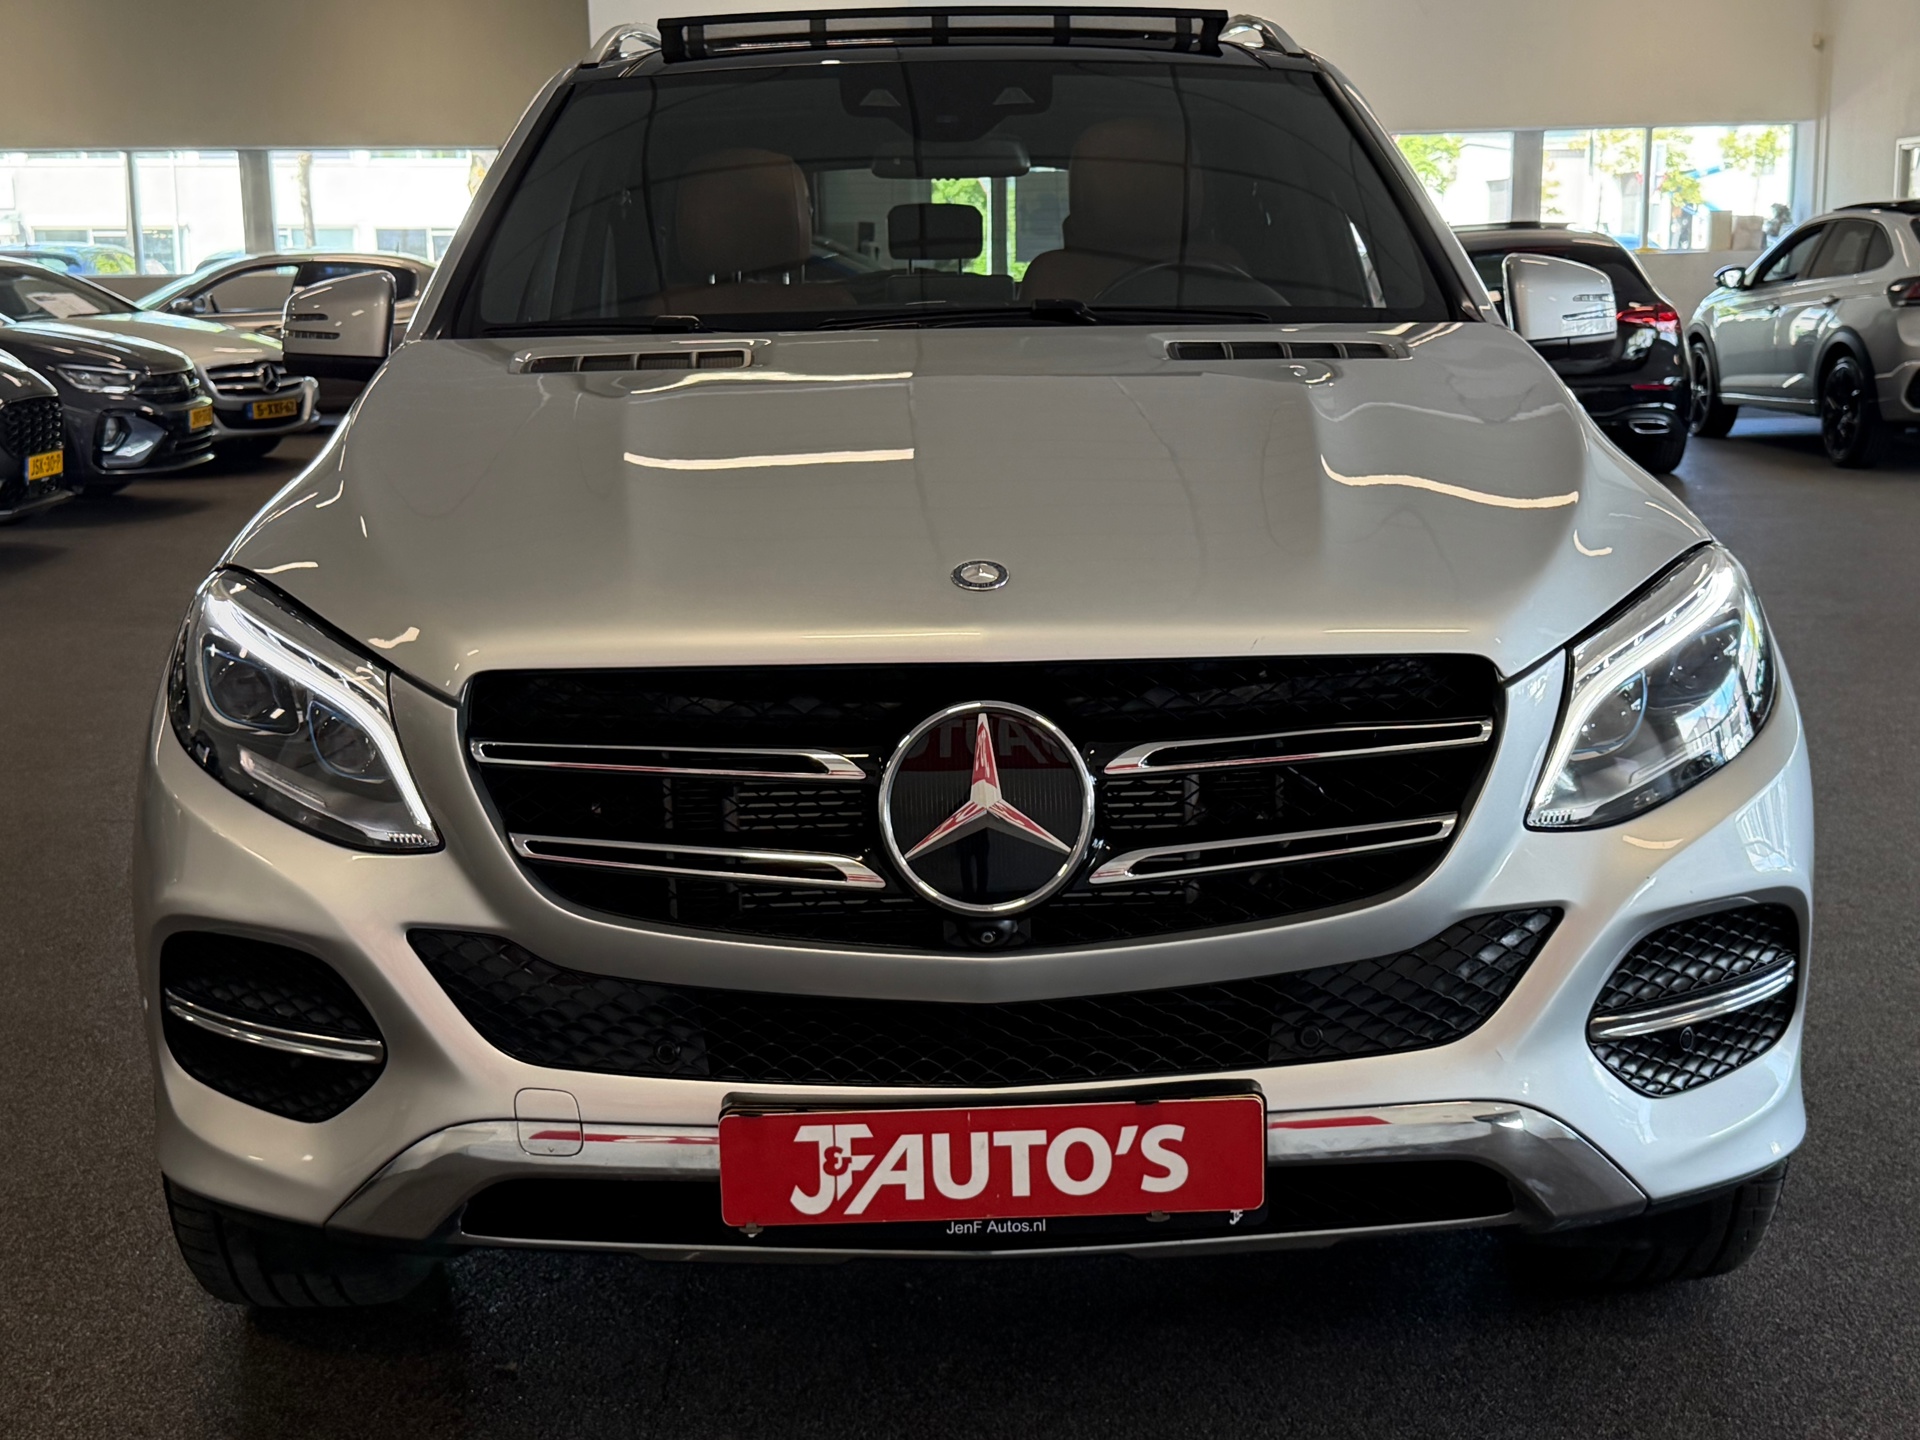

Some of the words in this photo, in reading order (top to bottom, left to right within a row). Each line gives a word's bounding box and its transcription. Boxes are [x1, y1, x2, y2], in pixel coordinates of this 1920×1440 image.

[844, 1124, 1189, 1215] AUTO'S
[946, 1220, 983, 1235] JenF
[987, 1218, 1047, 1233] Autos.nl
